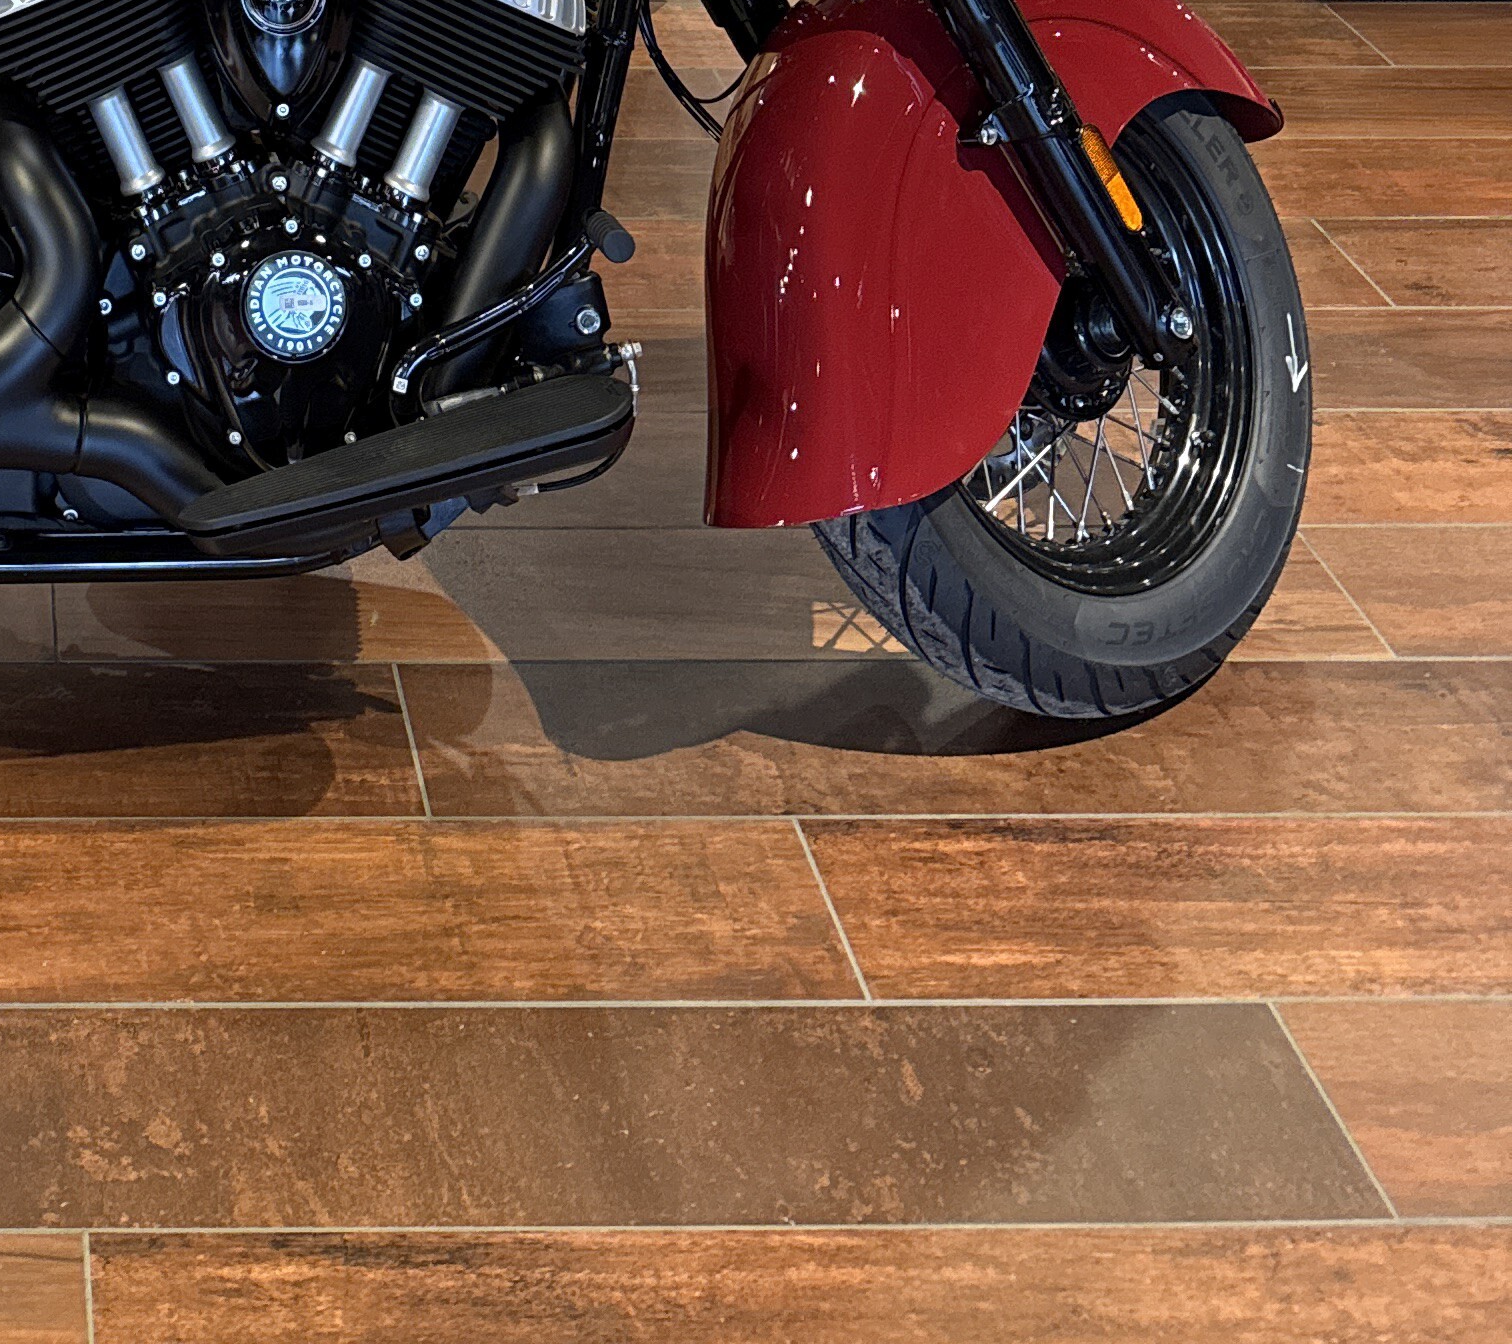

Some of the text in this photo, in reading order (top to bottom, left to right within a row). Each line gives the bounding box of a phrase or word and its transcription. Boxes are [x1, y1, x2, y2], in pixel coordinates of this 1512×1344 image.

[250, 254, 343, 336] INDIAN MOTORCYCLE
[277, 338, 313, 352] 1901
